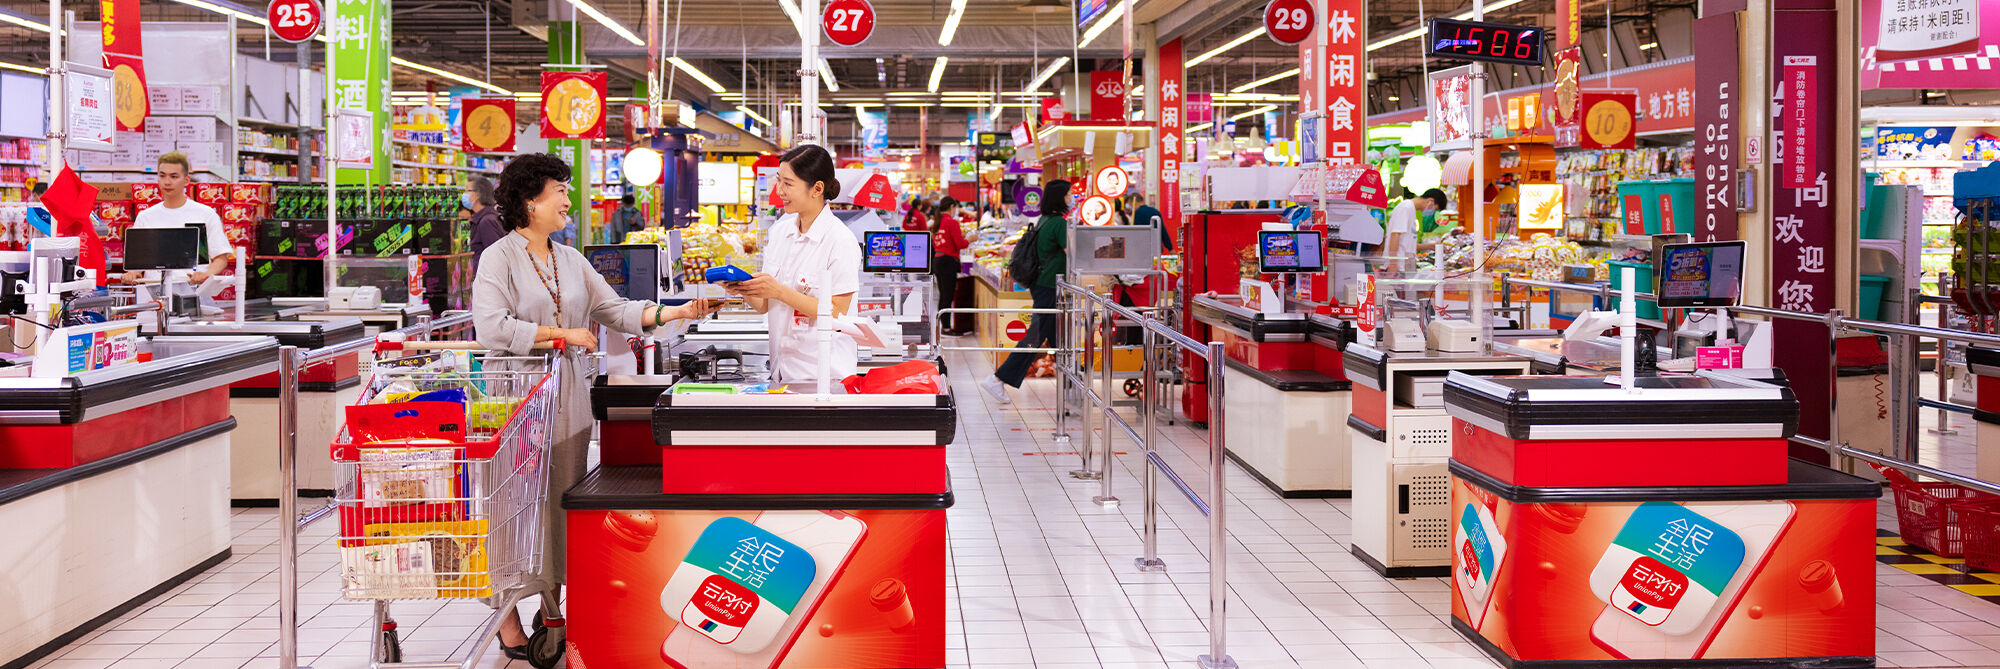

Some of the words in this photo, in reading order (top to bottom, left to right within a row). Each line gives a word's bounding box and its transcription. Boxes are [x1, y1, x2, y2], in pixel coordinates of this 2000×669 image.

[277, 3, 312, 28] 25
[832, 9, 863, 32] 27
[1274, 8, 1308, 30] 29
[1453, 27, 1535, 59] 1506
[1328, 9, 1356, 167] 休闲食品
[1649, 87, 1695, 120] 地方特
[1161, 79, 1179, 183] 休闲食品
[1704, 123, 1716, 155] to
[1795, 70, 1806, 183] 消防卷帘门下请勿堆放物品
[1716, 82, 1729, 208] Auchan
[1647, 532, 1699, 571] 生活
[1665, 518, 1714, 554] 全民
[718, 550, 770, 589] 生活
[737, 536, 785, 572] 全民
[1632, 564, 1682, 597] 云闪付
[1633, 582, 1665, 602] UnionPay
[703, 582, 752, 615] 云闪付
[704, 600, 735, 620] UnionPay
